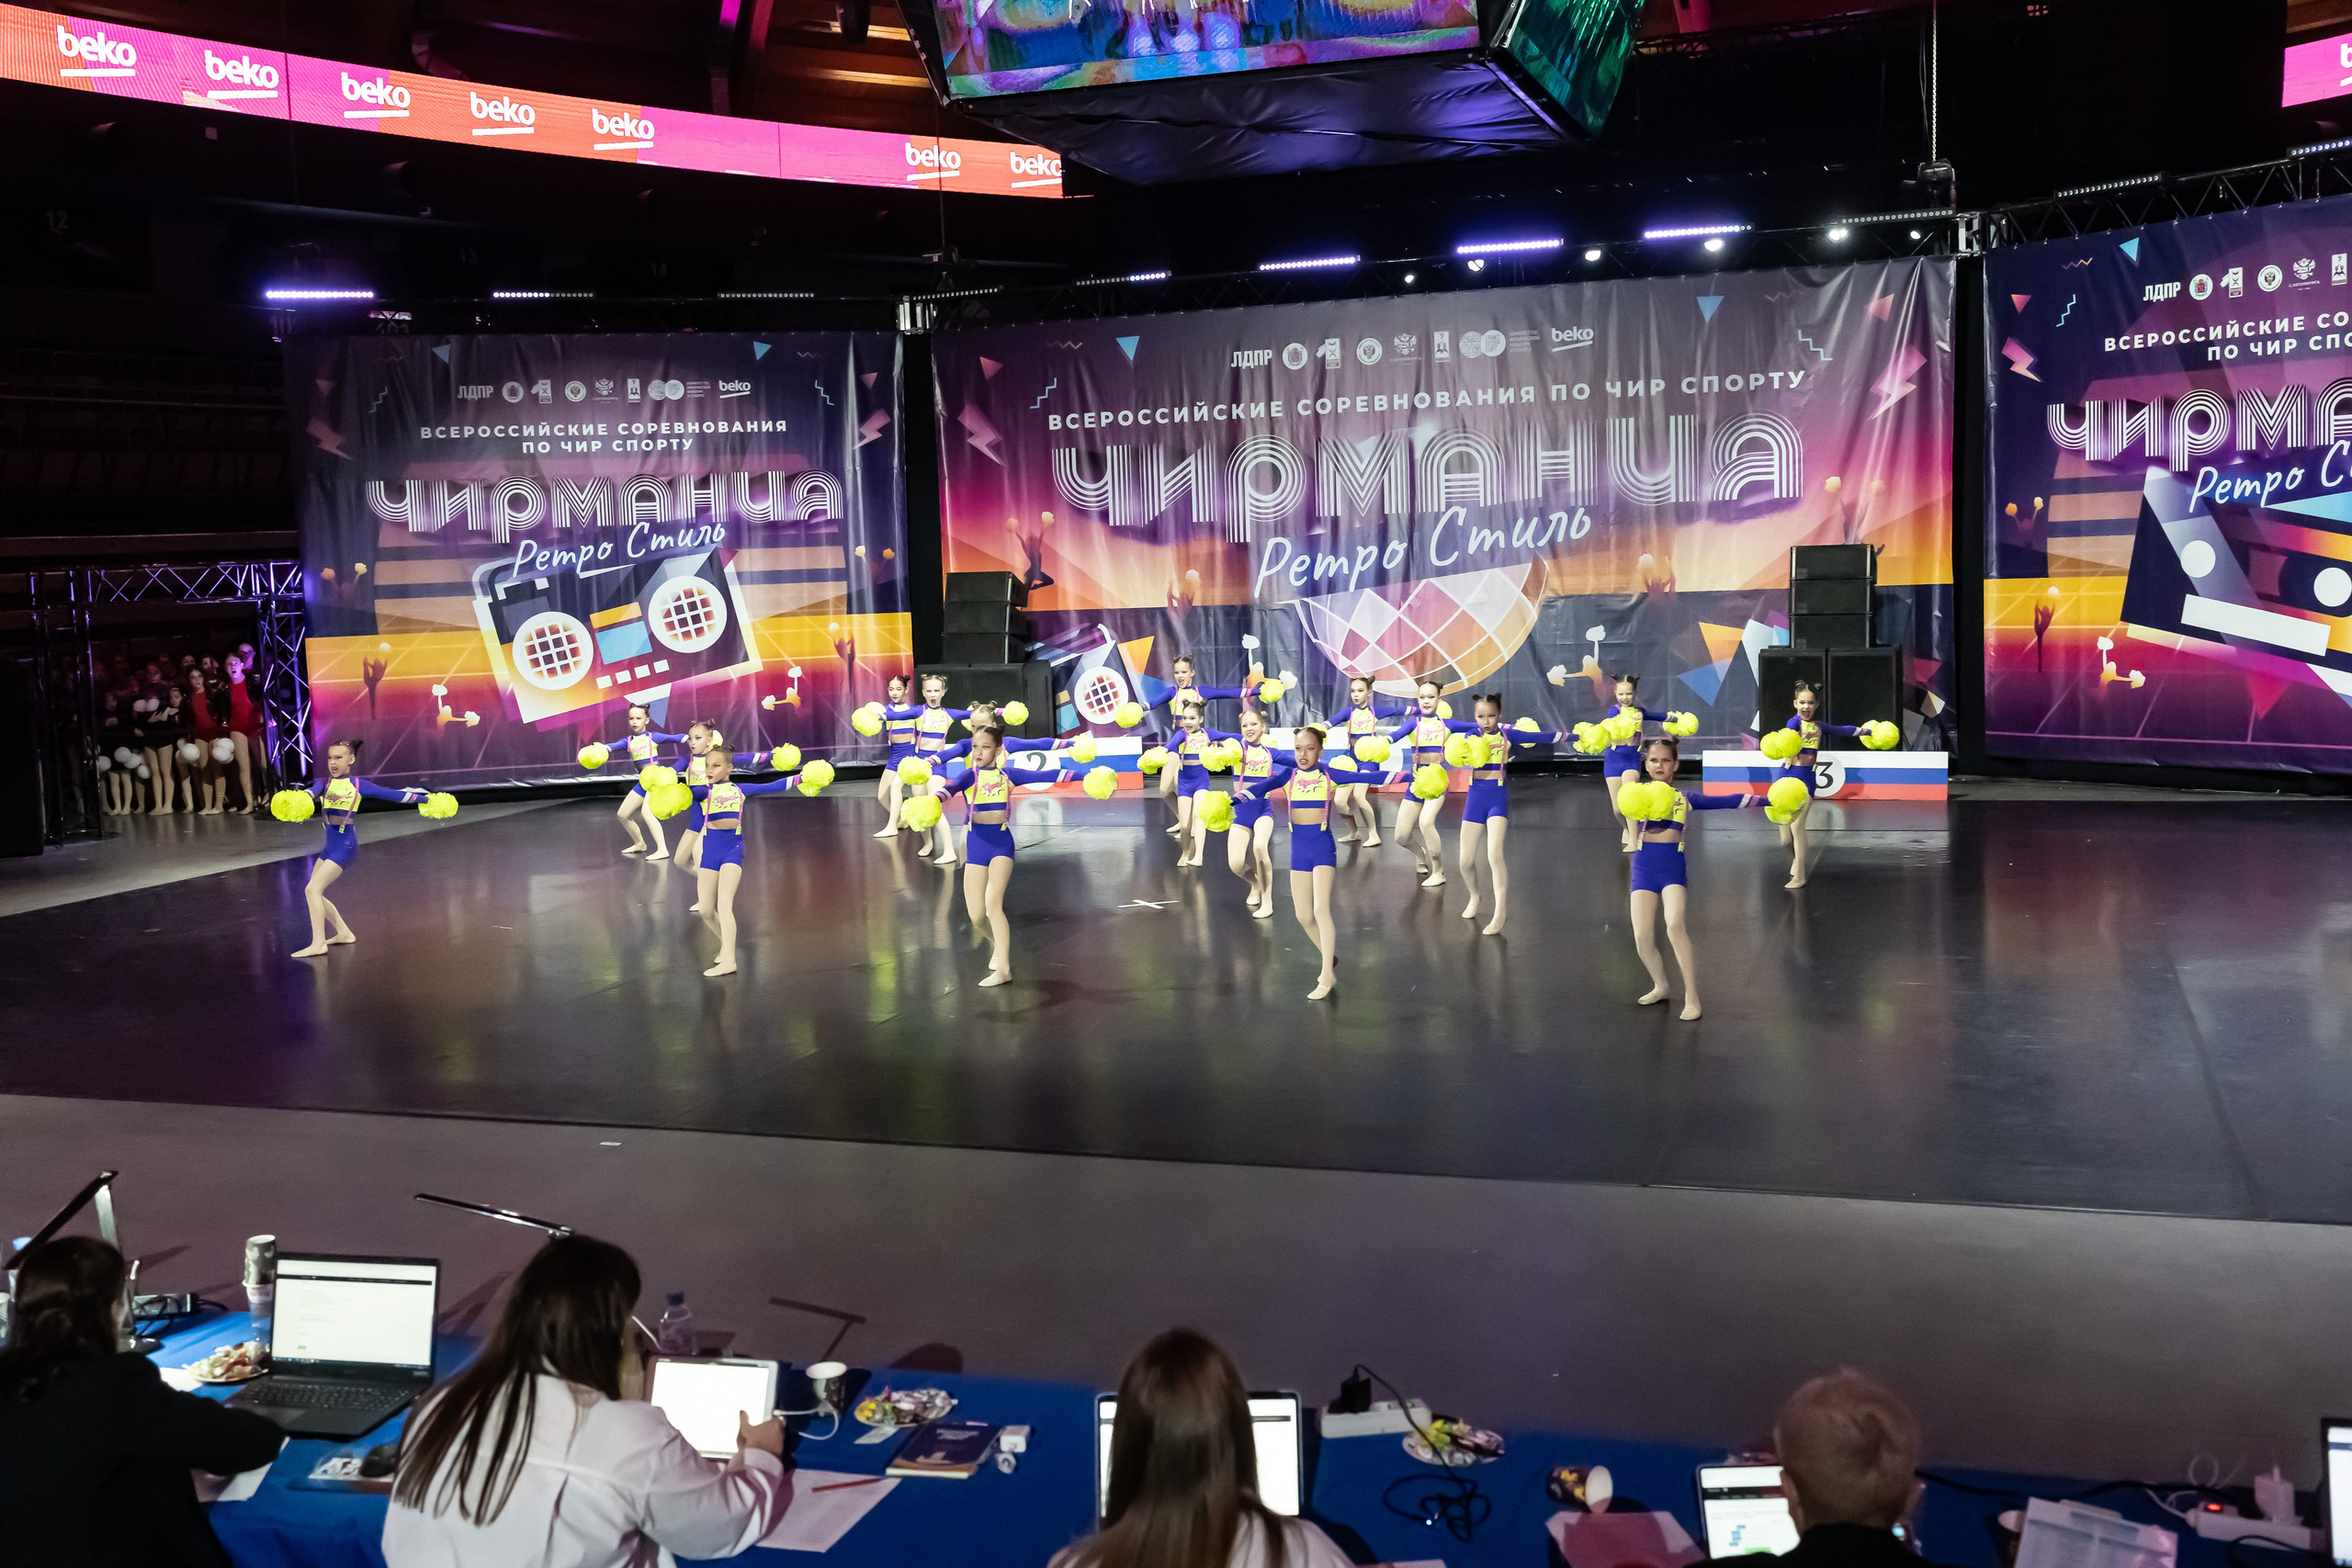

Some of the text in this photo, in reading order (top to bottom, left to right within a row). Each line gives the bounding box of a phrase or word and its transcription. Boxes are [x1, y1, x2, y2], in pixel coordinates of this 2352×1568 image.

[56, 25, 137, 67] beko
[204, 50, 278, 89] beko
[341, 72, 411, 109] beko
[469, 92, 536, 126] beko
[591, 107, 655, 140] beko
[905, 141, 961, 169] beko
[2143, 281, 2181, 302] ЛДПР
[1551, 326, 1594, 343] beko
[2104, 316, 2305, 352] ВСЕРОССИЙСКИЕ
[1231, 349, 1272, 369] ЛДПР
[2207, 344, 2239, 361] ПО
[2250, 339, 2298, 356] ЧИР
[457, 385, 494, 400] ЛДПР
[718, 379, 752, 392] beko
[1048, 369, 1805, 431] ВСЕРОССИЙСКИЕ СОРЕВНОВАНИЯ ПО ЧИР СПОРТУ
[420, 420, 787, 440] ВСЕРОССИЙСКИЕ СОРЕВНОВАНИЯ
[522, 438, 694, 454] ПО ЧИР СПОРТУ
[2188, 466, 2305, 513] Ретро
[513, 521, 726, 579] Ретро Стиль
[1254, 506, 1592, 599] Ретро Стиль
[1815, 761, 1834, 789] 3
